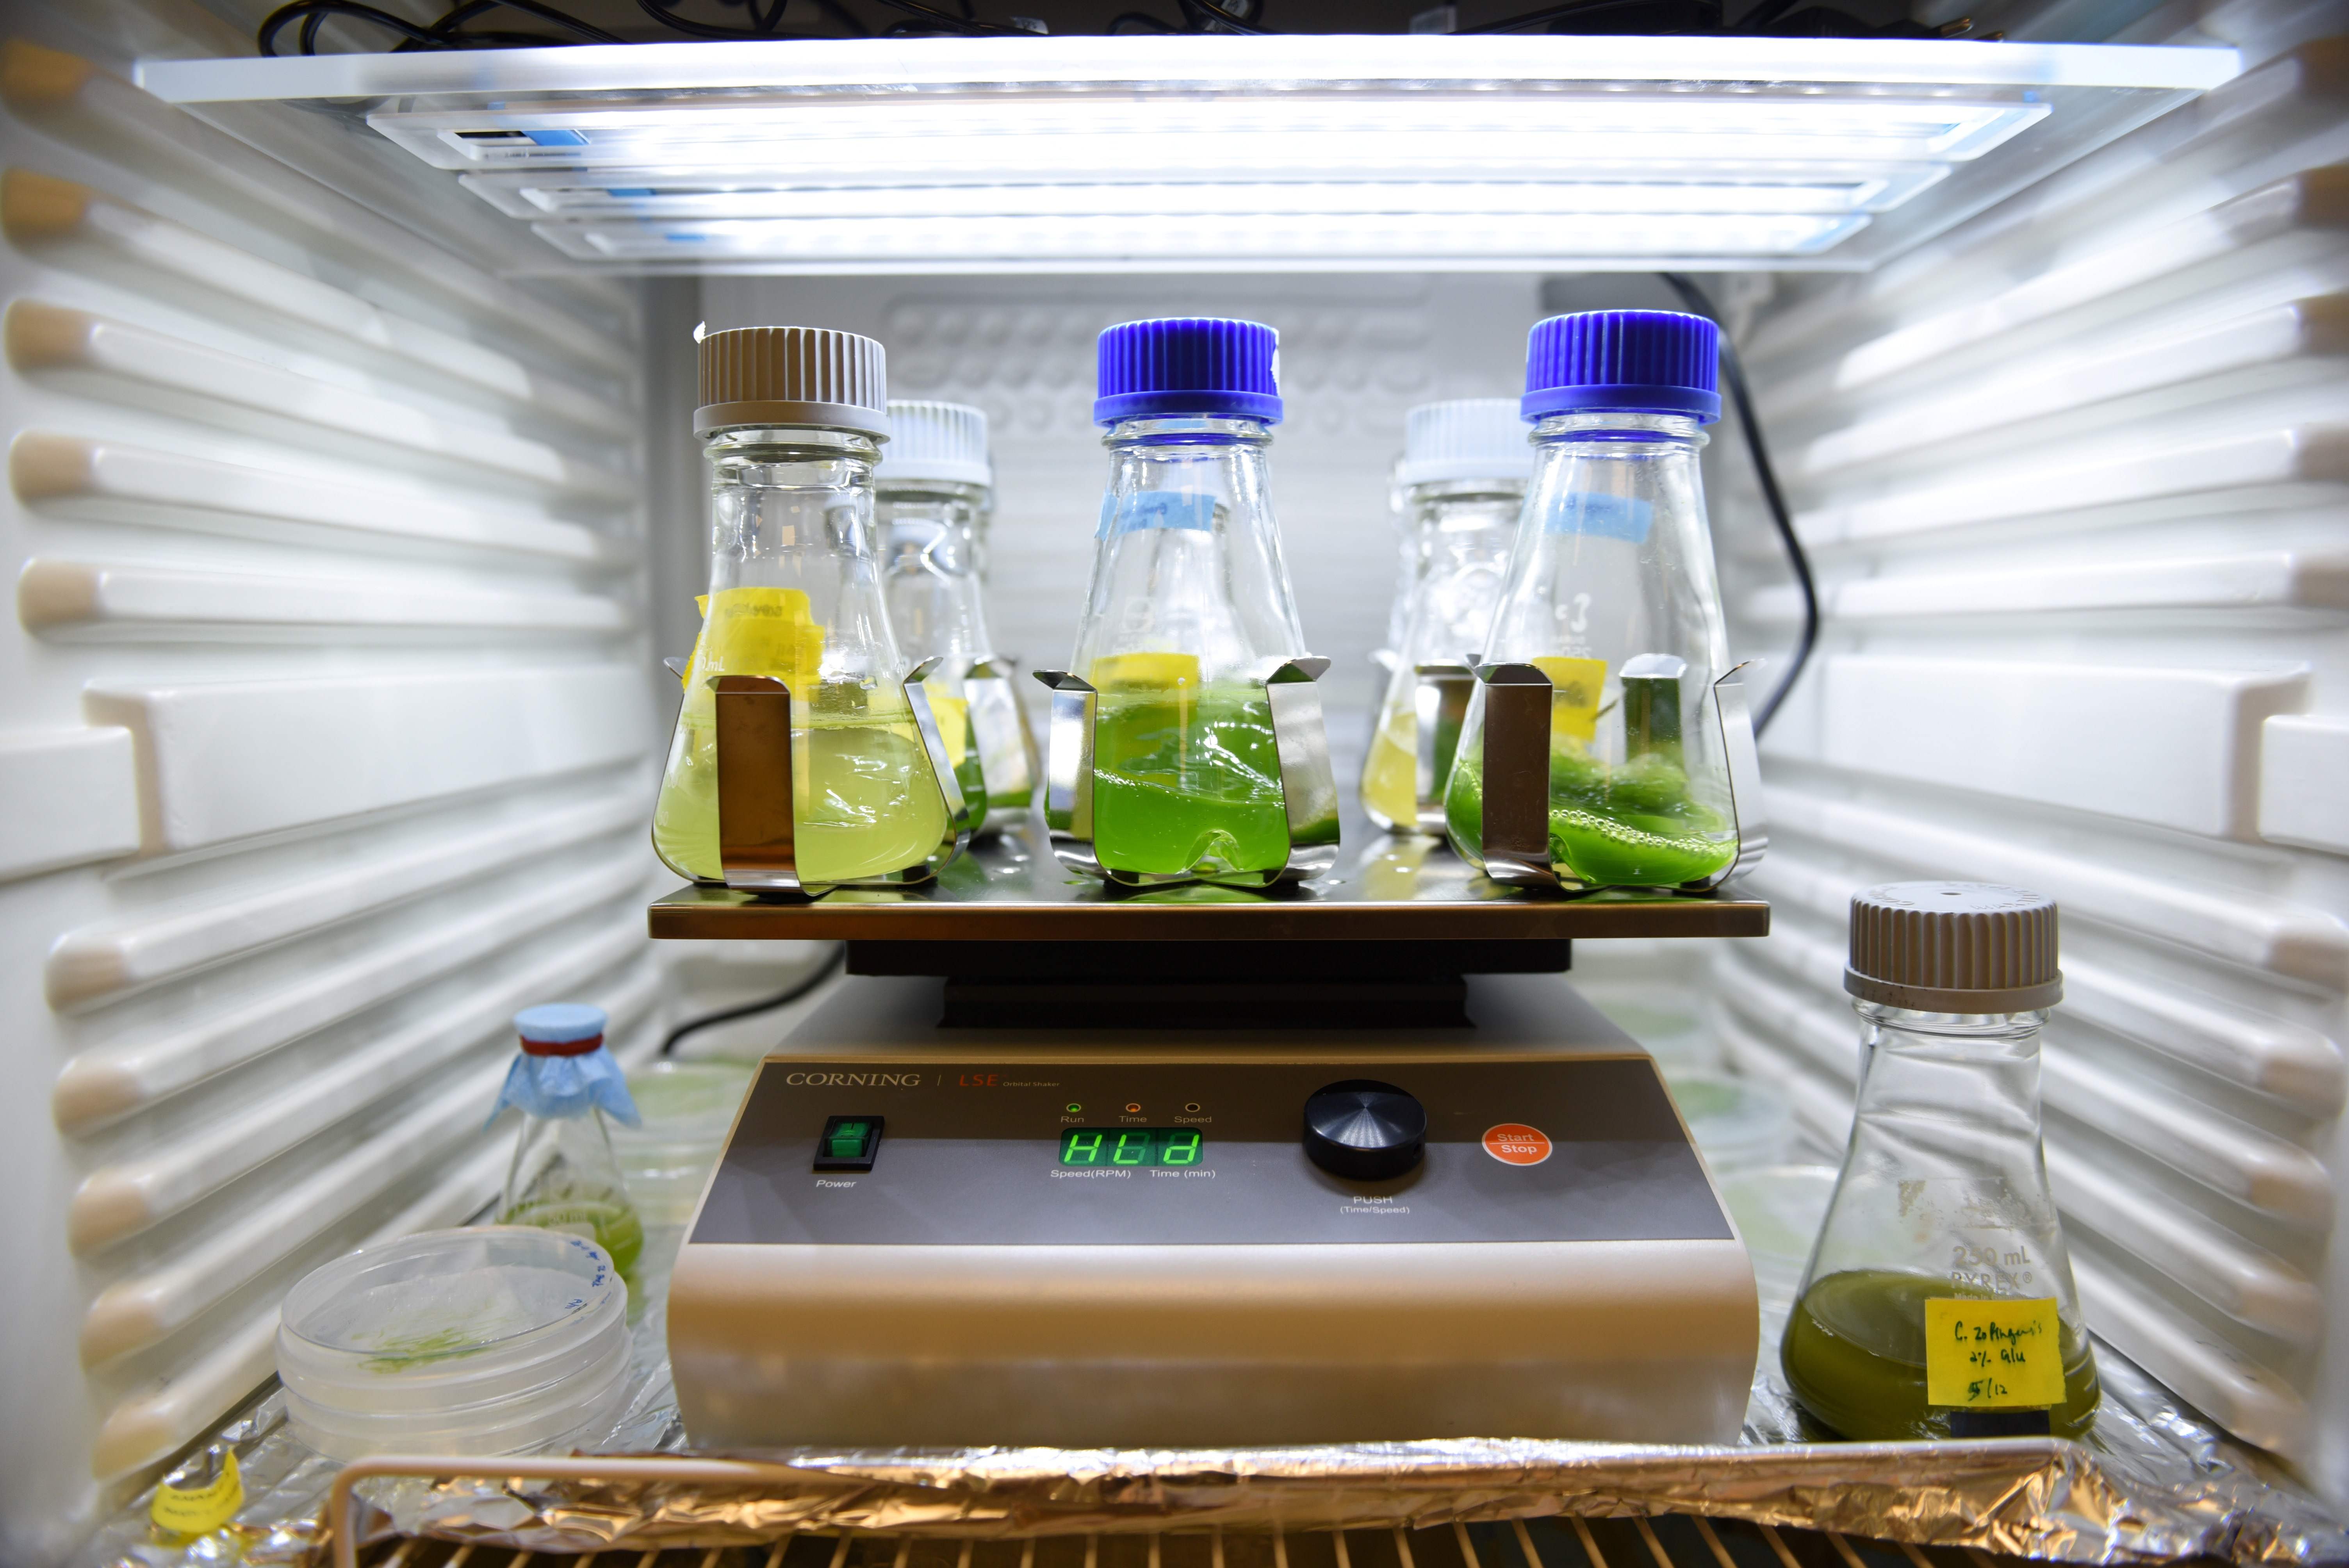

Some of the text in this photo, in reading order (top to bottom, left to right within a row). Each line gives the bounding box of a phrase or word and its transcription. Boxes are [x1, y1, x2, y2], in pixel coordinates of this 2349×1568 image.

[786, 1073, 921, 1086] CORNING
[959, 1074, 1000, 1087] LSE
[1174, 1116, 1212, 1124] Speed
[1497, 1133, 1534, 1142] Start
[1501, 1144, 1537, 1155] Stop
[1050, 1170, 1131, 1178] Speed(RPM)
[1184, 1170, 1216, 1178] (min)
[816, 1180, 857, 1188] Power
[1353, 1196, 1393, 1204] PUSH
[1340, 1206, 1410, 1215] (Time/Speed)
[1952, 1245, 2030, 1267] 250 mL
